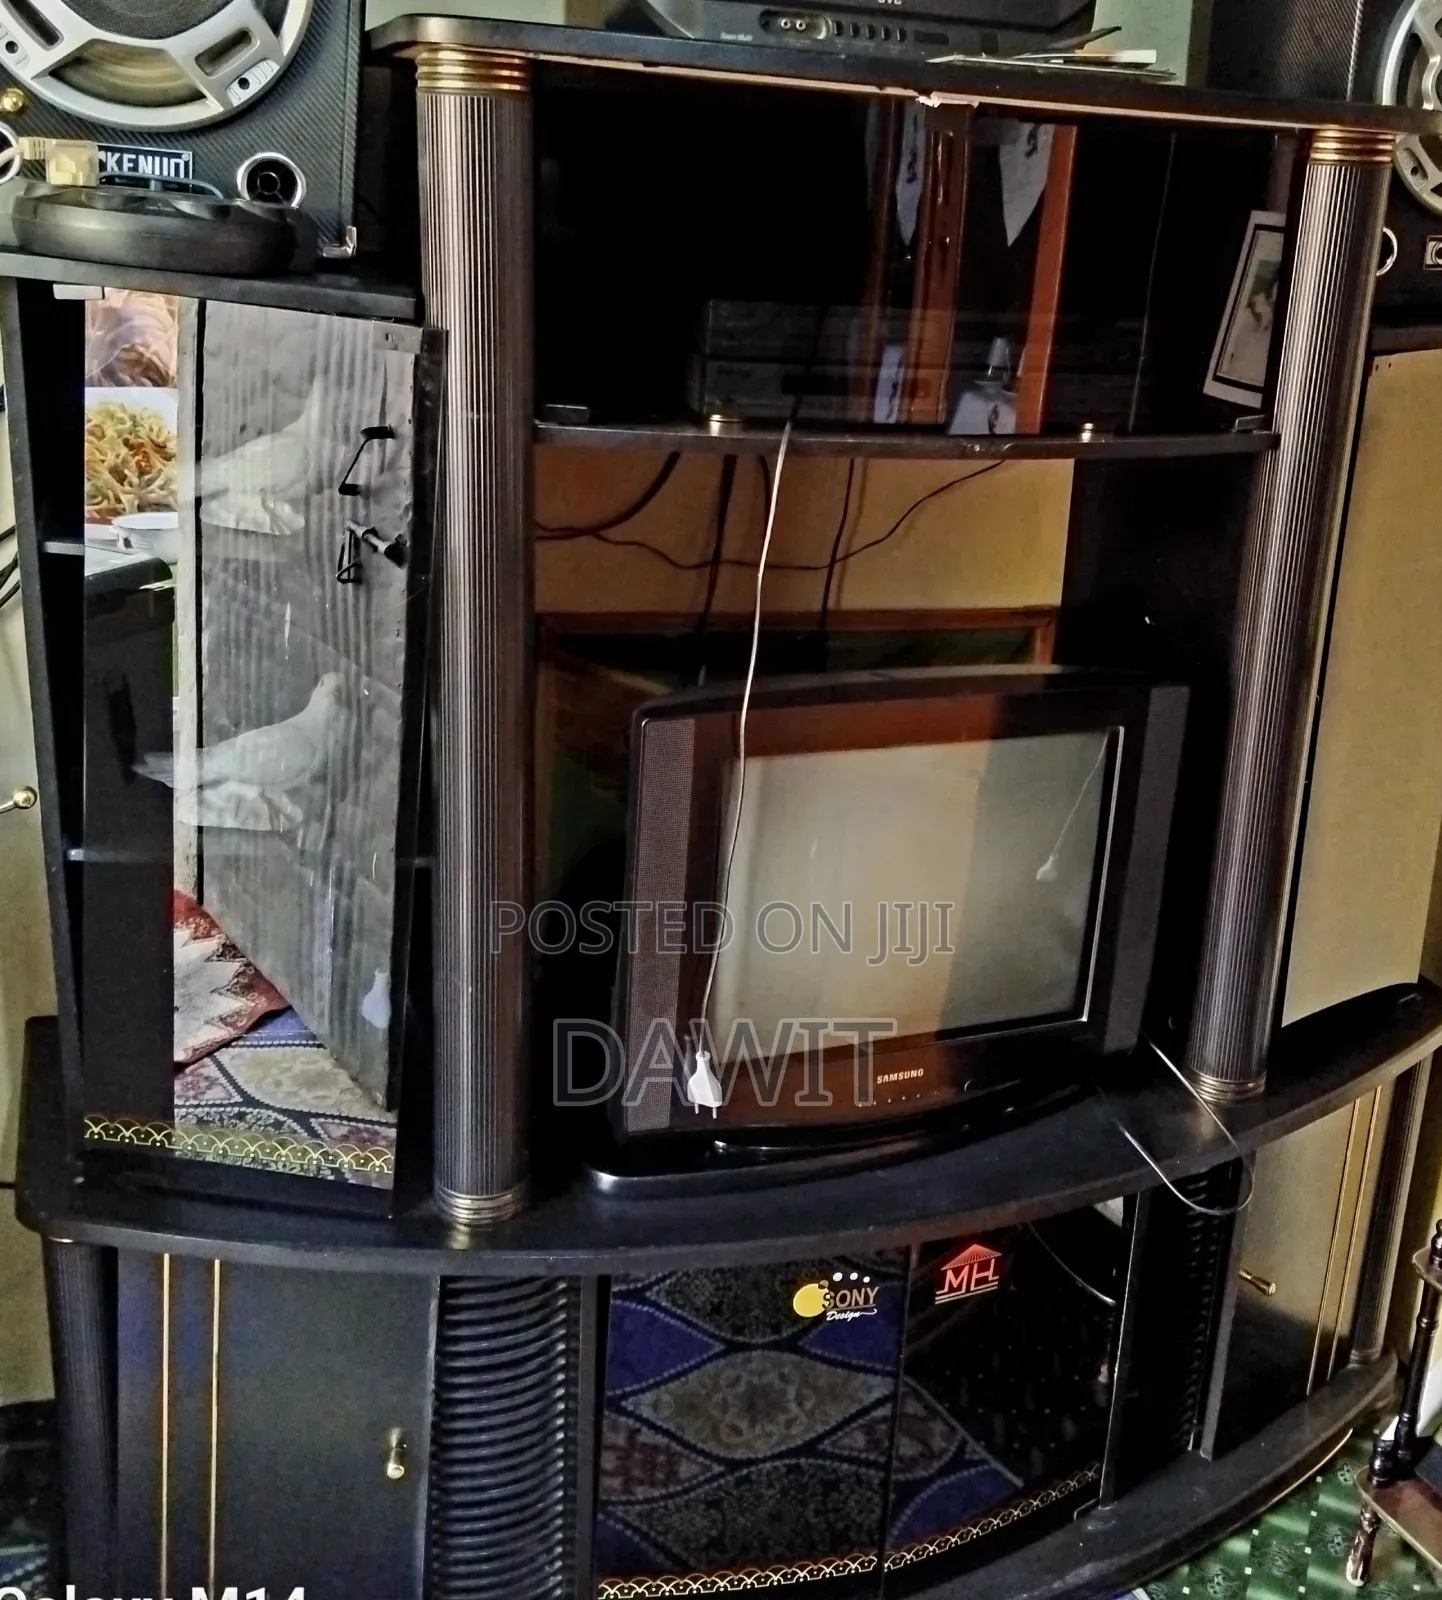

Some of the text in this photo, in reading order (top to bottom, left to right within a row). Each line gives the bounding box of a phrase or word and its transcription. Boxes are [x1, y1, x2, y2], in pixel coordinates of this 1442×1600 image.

[876, 1068, 925, 1085] SAMSUNG
[821, 1286, 880, 1310] SONY
[826, 1307, 877, 1322] Design
